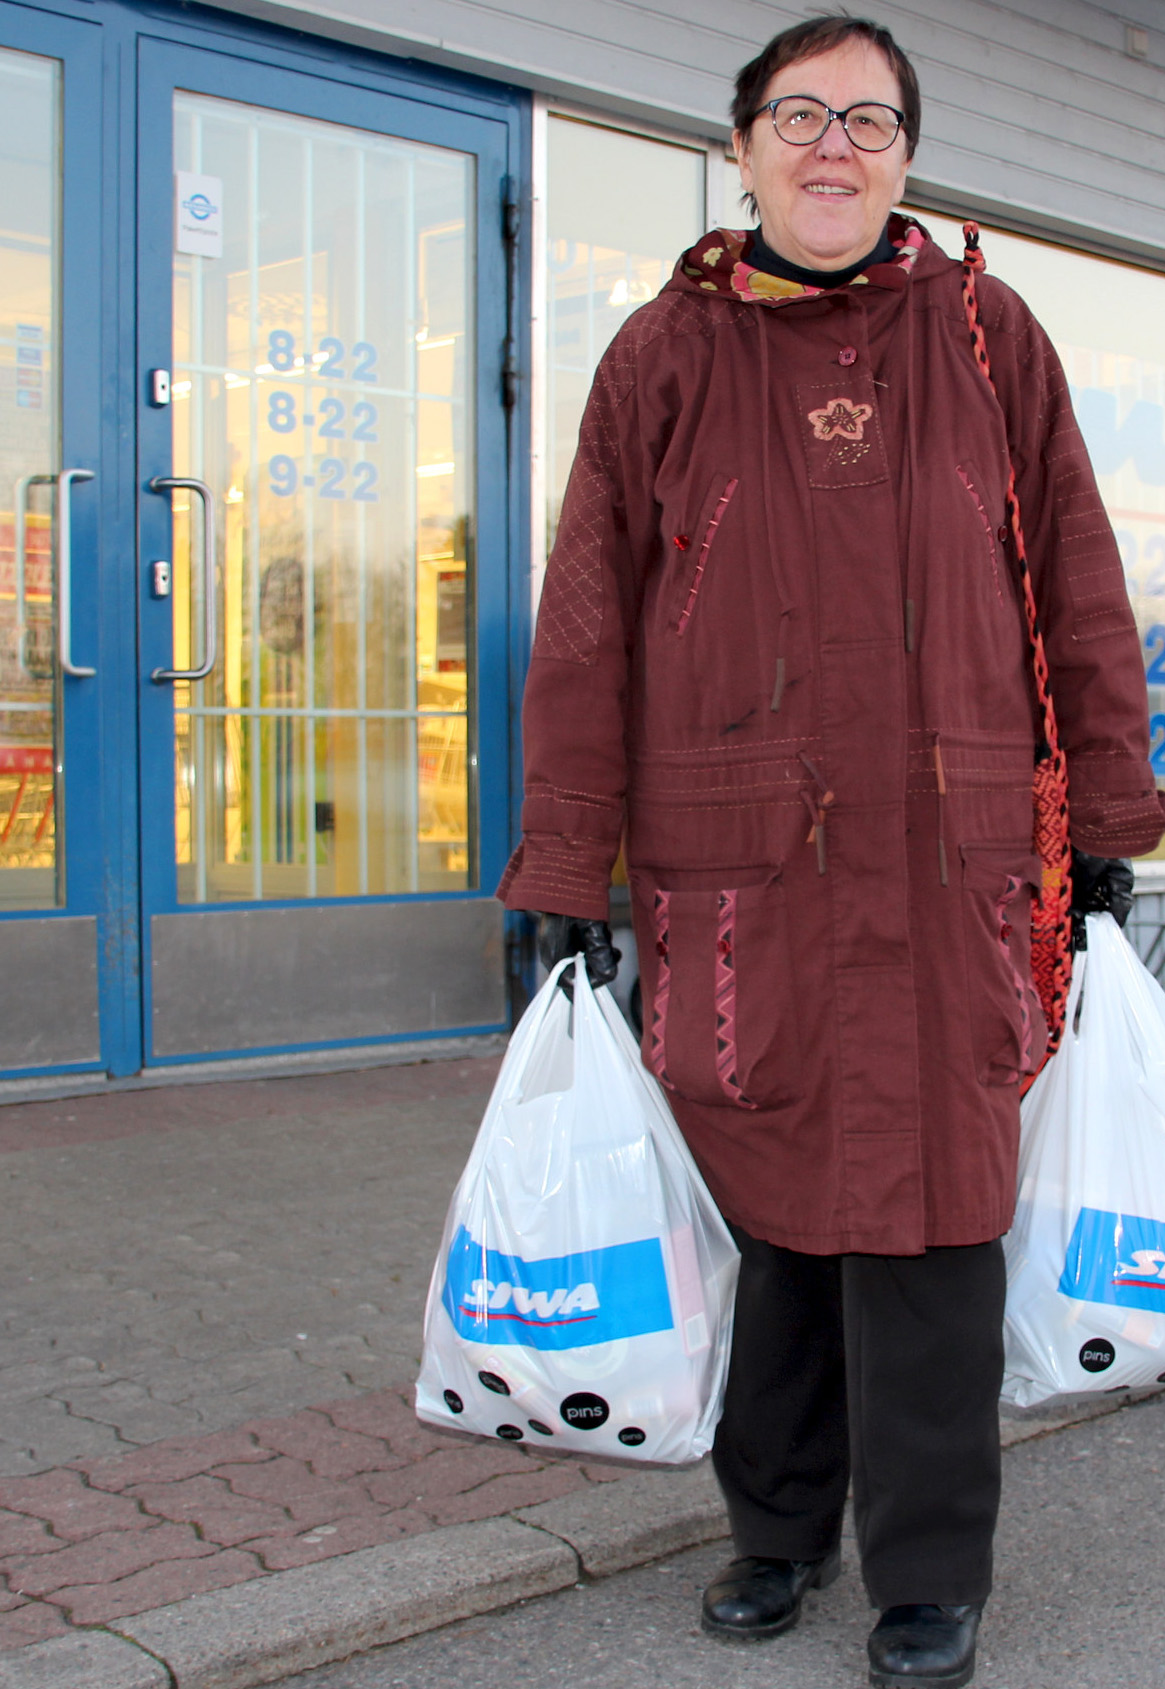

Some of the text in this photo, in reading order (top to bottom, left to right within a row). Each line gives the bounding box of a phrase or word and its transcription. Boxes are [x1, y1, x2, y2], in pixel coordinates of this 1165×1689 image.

[267, 329, 378, 383] 8-22
[267, 391, 378, 442] 8-22
[268, 454, 378, 502] 9-22
[464, 1279, 600, 1318] SIWA
[1083, 1351, 1111, 1363] pins
[567, 1405, 603, 1421] pins
